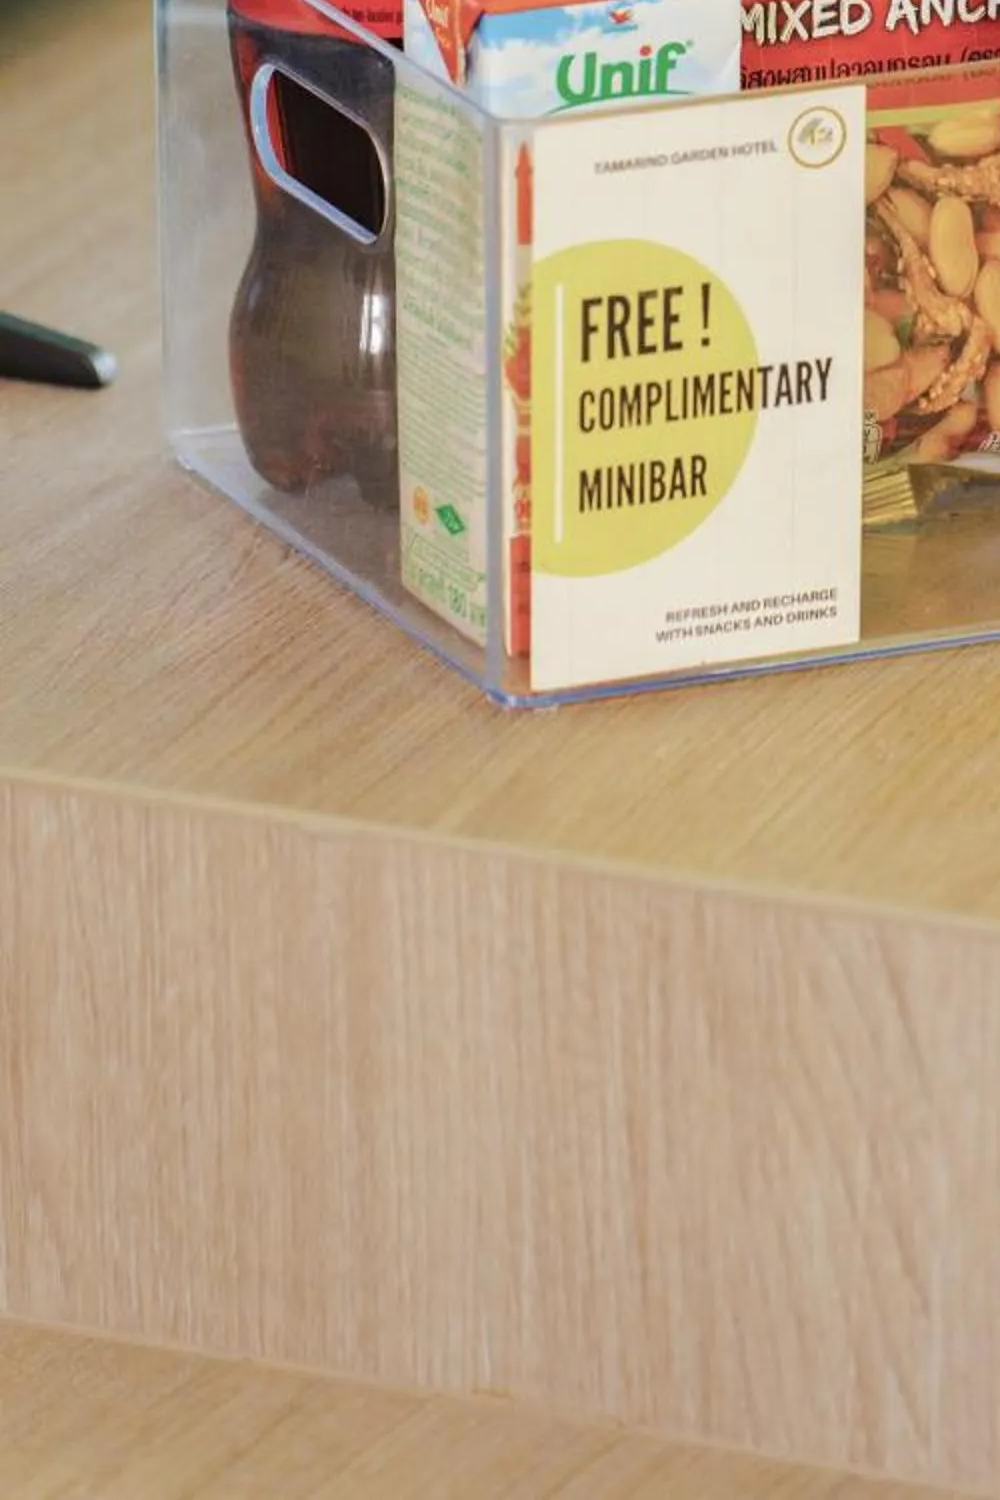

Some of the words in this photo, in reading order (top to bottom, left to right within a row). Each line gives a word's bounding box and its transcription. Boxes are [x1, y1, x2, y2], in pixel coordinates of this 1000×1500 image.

[556, 41, 687, 101] Unif
[671, 146, 730, 165] GARDEN
[731, 139, 778, 157] HOTEL
[580, 285, 684, 363] FREE
[700, 282, 711, 348] !
[578, 357, 833, 434] COMPLIMENTARY
[578, 454, 708, 513] MINIBAR
[655, 628, 694, 643] WITH
[694, 619, 751, 637] SNACKS
[753, 612, 784, 629] AND
[786, 605, 838, 624] DRINKS
[665, 603, 728, 624] REFRESH
[730, 599, 761, 614] AND
[763, 587, 838, 609] RECHARGE
